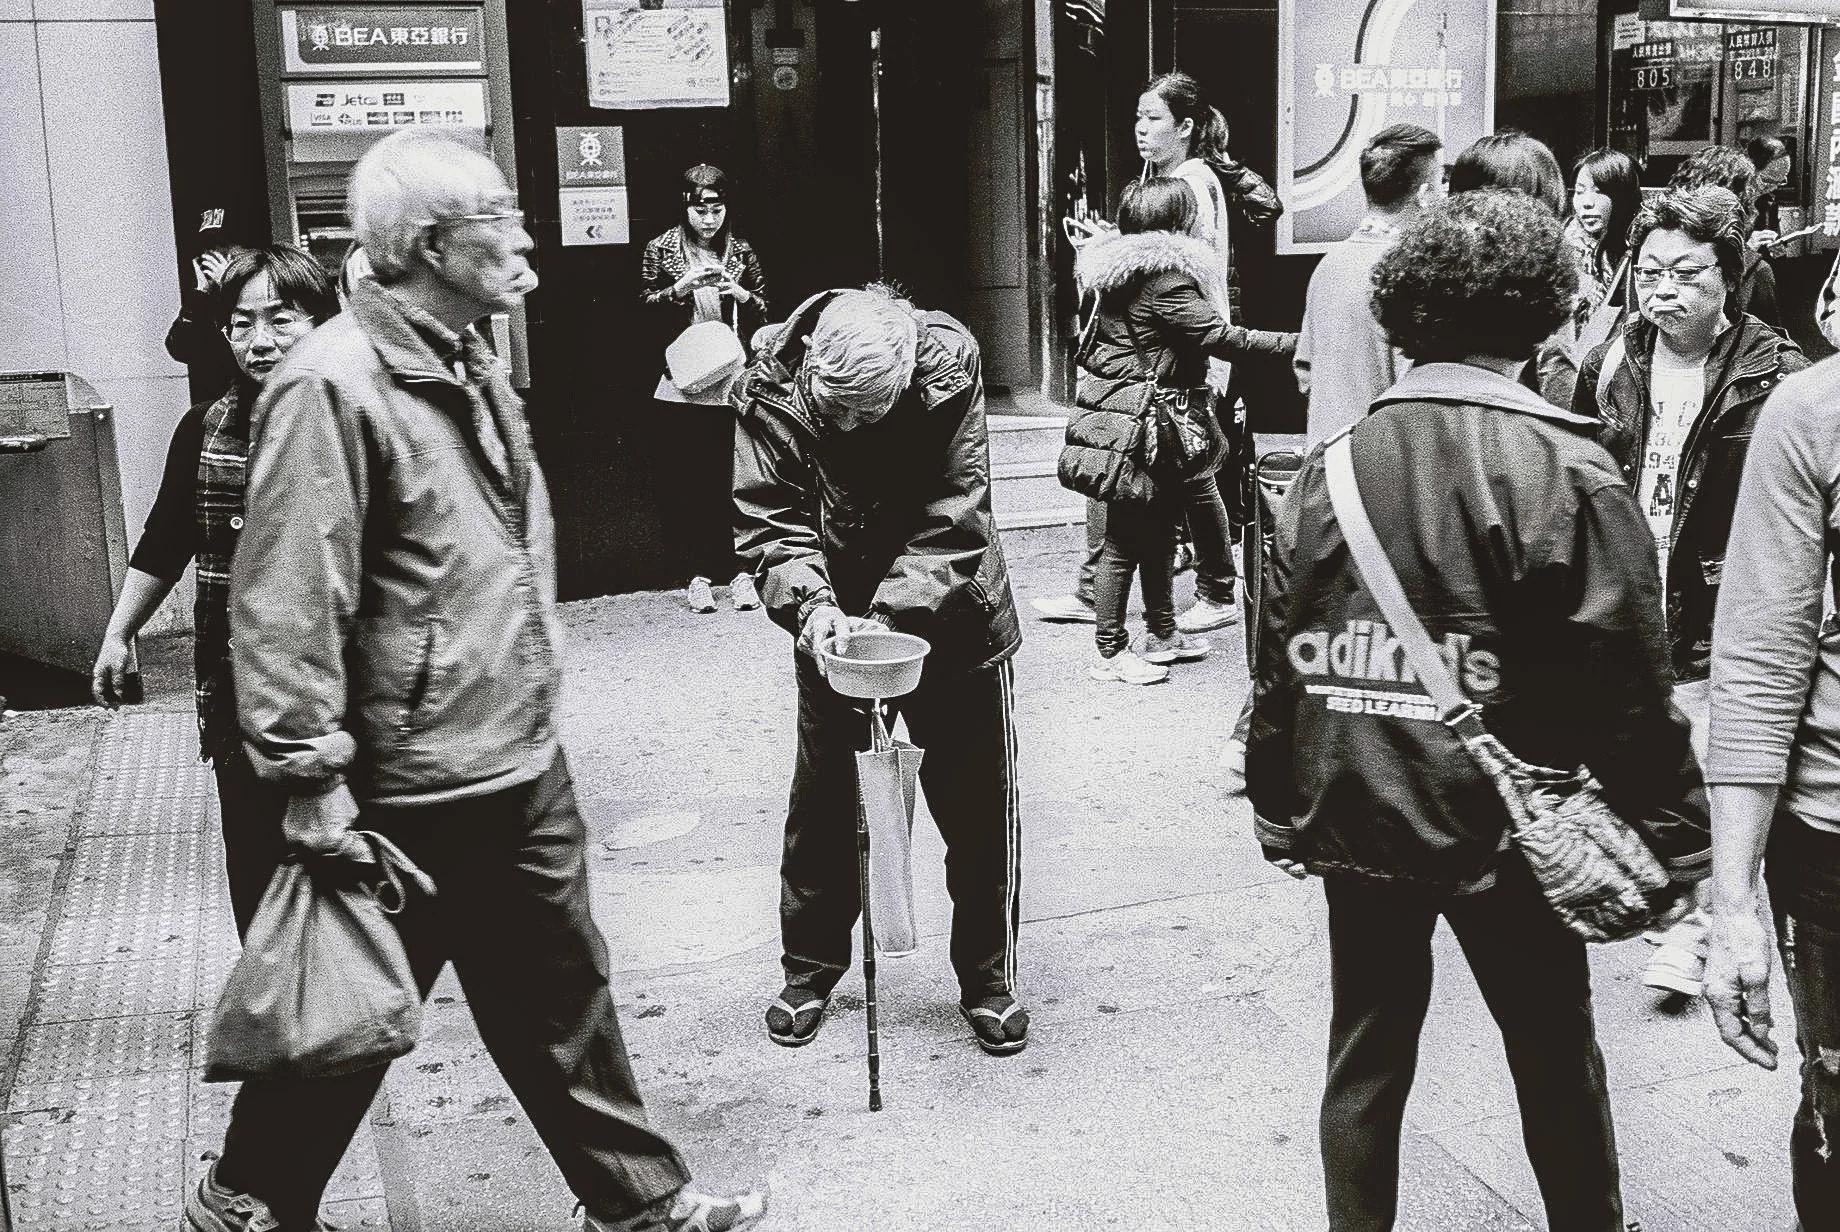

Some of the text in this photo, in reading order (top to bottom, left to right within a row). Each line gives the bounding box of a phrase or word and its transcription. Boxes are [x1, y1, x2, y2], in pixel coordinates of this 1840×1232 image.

[335, 27, 468, 45] BEA 東亞銀行
[1341, 69, 1388, 89] BEA
[1637, 68, 1670, 88] 805
[1734, 60, 1771, 80] 848
